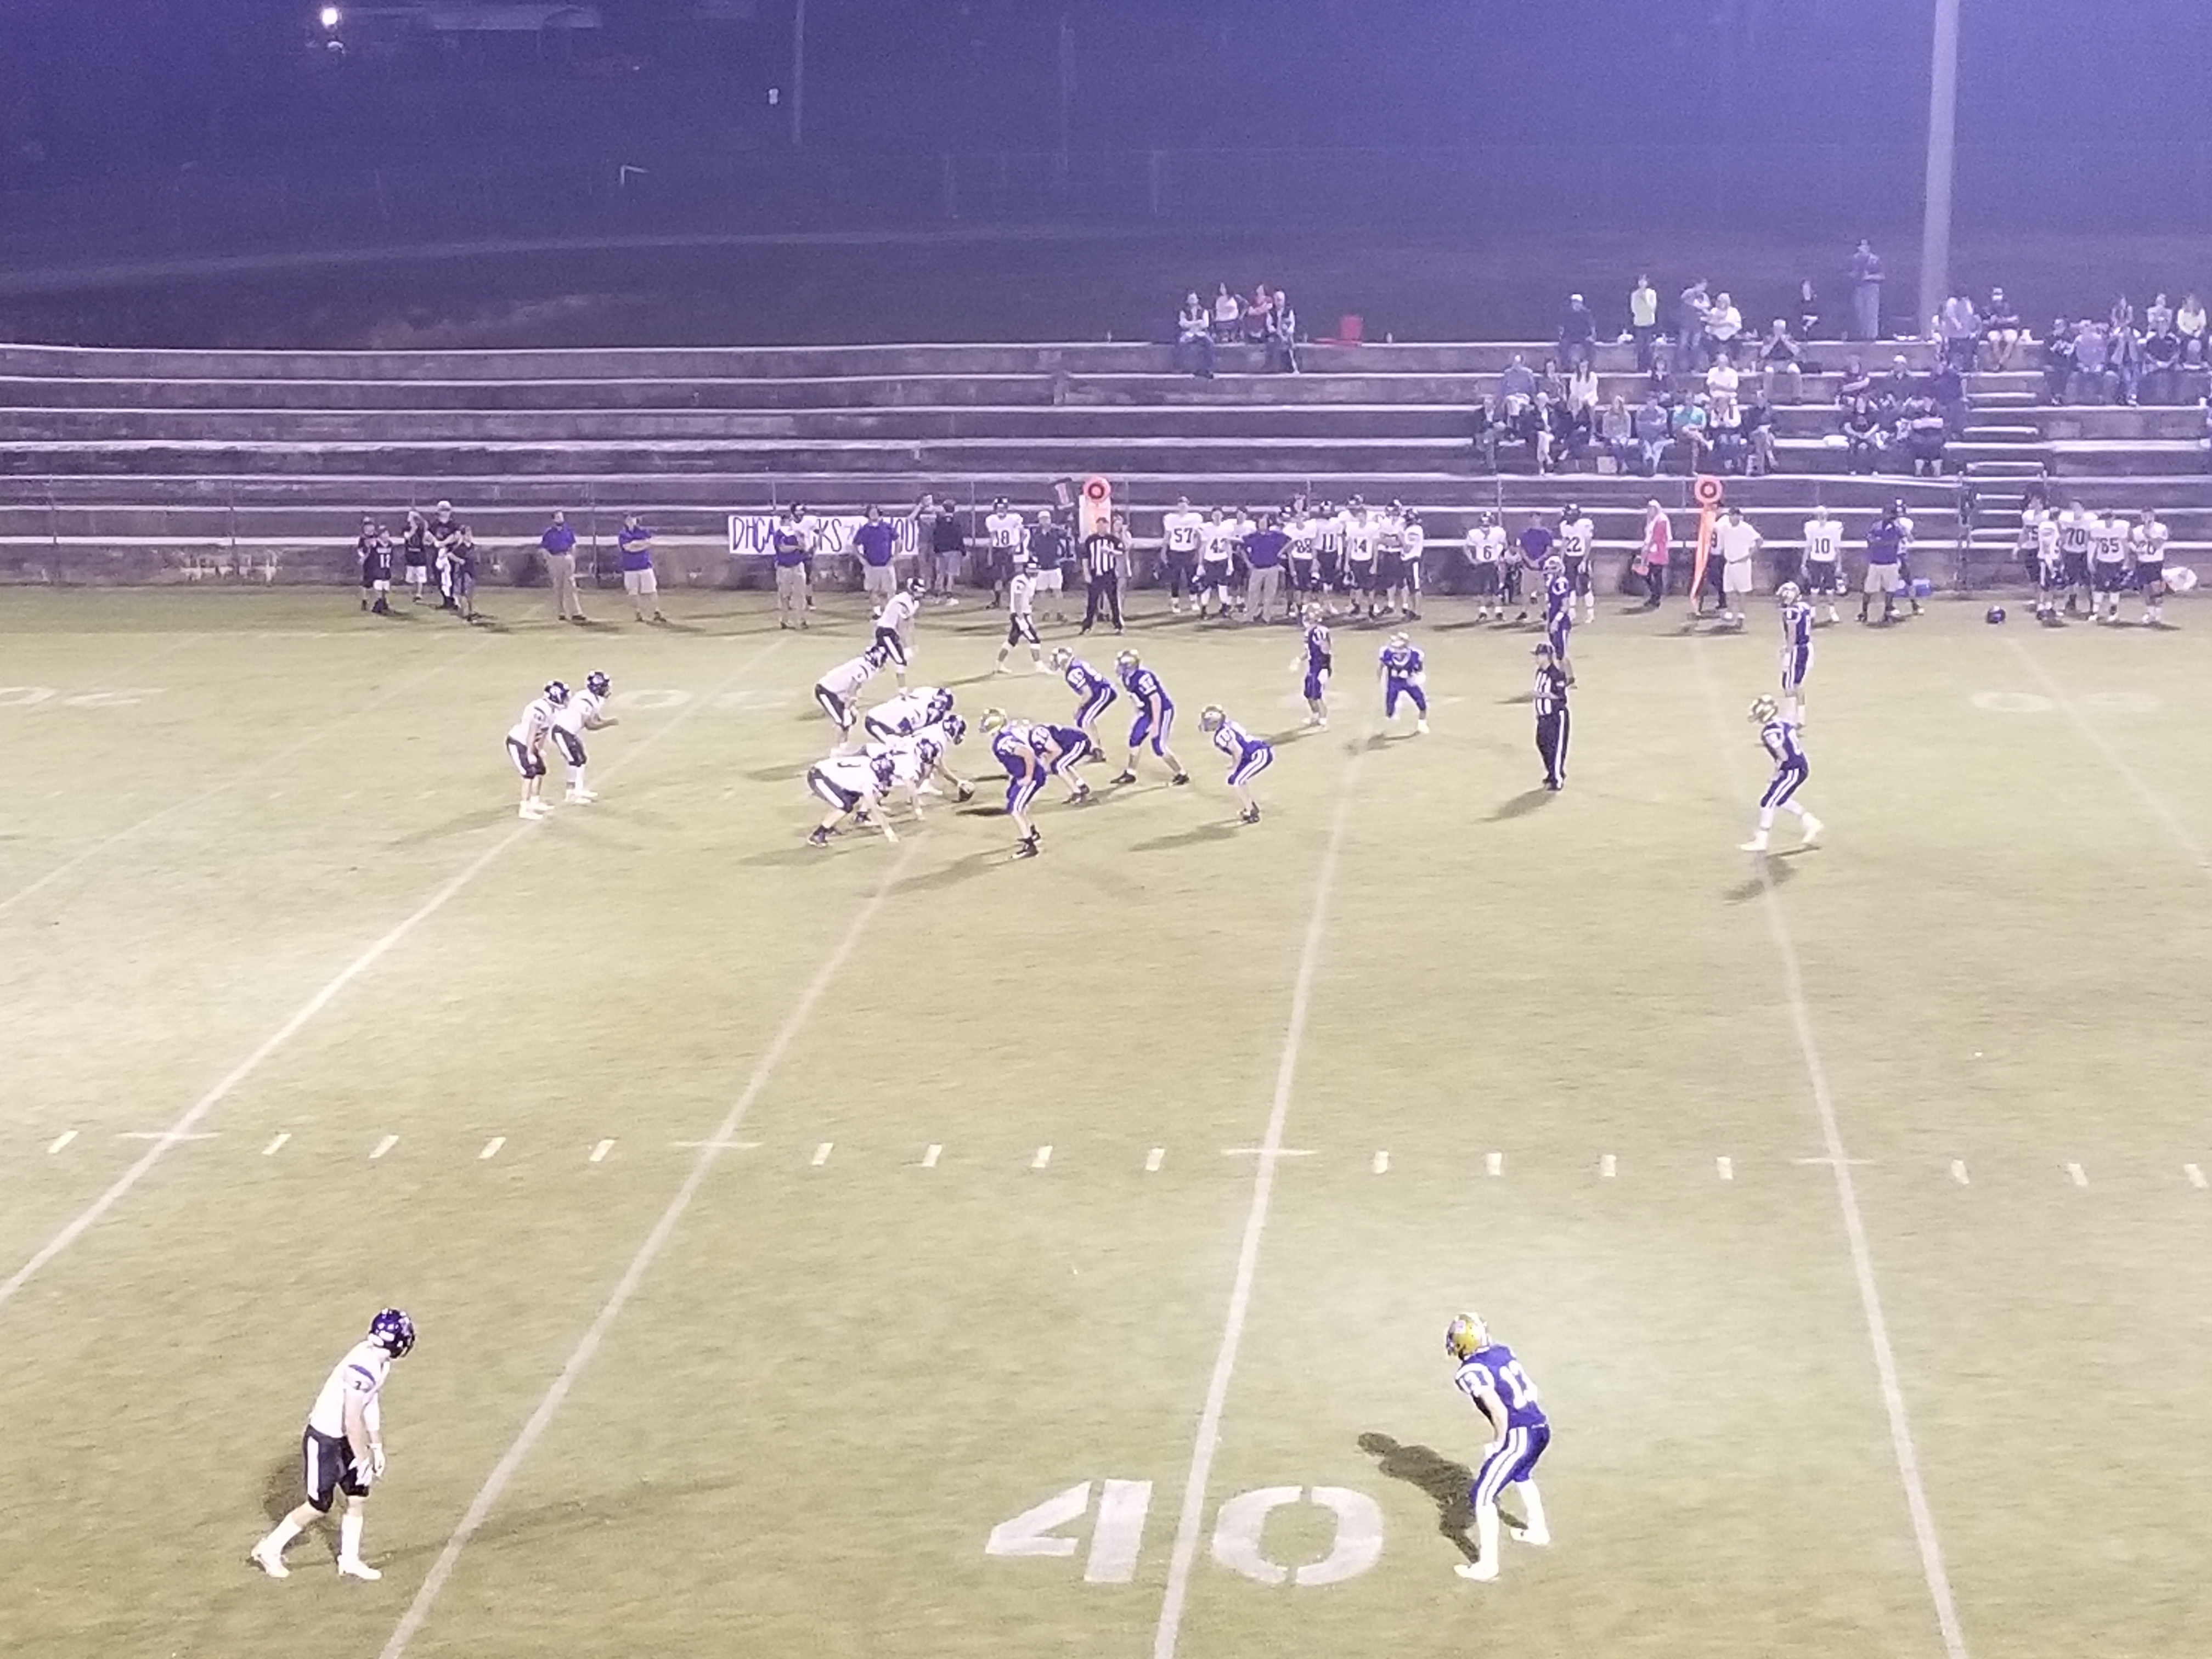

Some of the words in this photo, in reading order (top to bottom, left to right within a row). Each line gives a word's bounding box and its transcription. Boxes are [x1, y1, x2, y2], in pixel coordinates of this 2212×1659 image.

[996, 531, 1009, 546] 18
[1174, 528, 1192, 544] 57
[1323, 534, 1334, 550] 11
[2067, 528, 2085, 546] 70
[1353, 538, 1367, 552] 14
[1565, 537, 1582, 552] 22
[1815, 538, 1830, 554] 10
[2100, 538, 2119, 554] 65
[1483, 546, 1492, 560] 6
[985, 1478, 1385, 1588] 40
